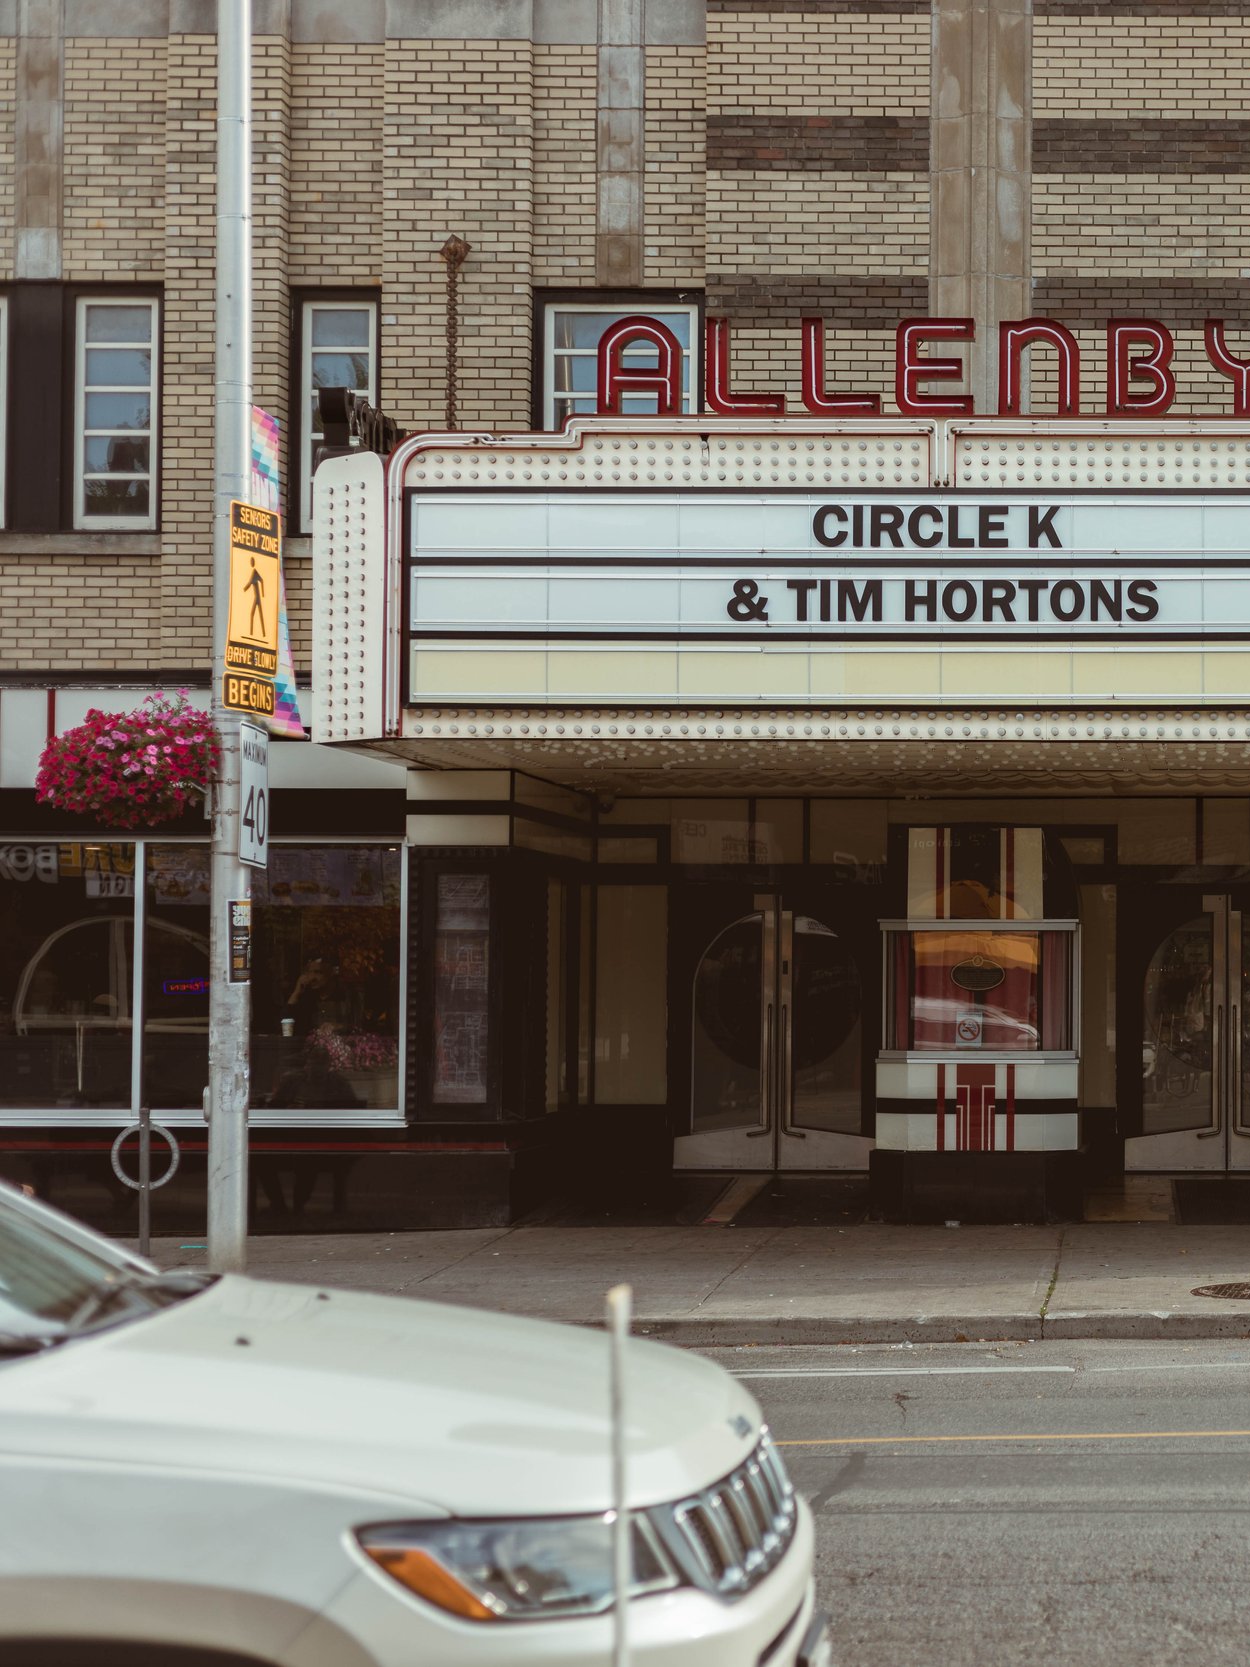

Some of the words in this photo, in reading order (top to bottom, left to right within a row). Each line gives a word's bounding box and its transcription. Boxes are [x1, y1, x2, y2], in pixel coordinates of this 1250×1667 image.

[240, 507, 271, 530] SENIORS
[811, 504, 1010, 549] CIRCLE
[1027, 505, 1063, 548] K
[232, 530, 260, 552] SAFETY
[260, 532, 278, 554] ZONE
[726, 579, 769, 622] &
[786, 579, 883, 622] TIM
[905, 579, 1159, 622] HORTONS
[227, 645, 252, 664] DRIVE
[253, 650, 277, 671] SLOWLY
[228, 677, 272, 711] BEGINS
[243, 740, 266, 767] MAXIMUM
[242, 785, 266, 847] 40
